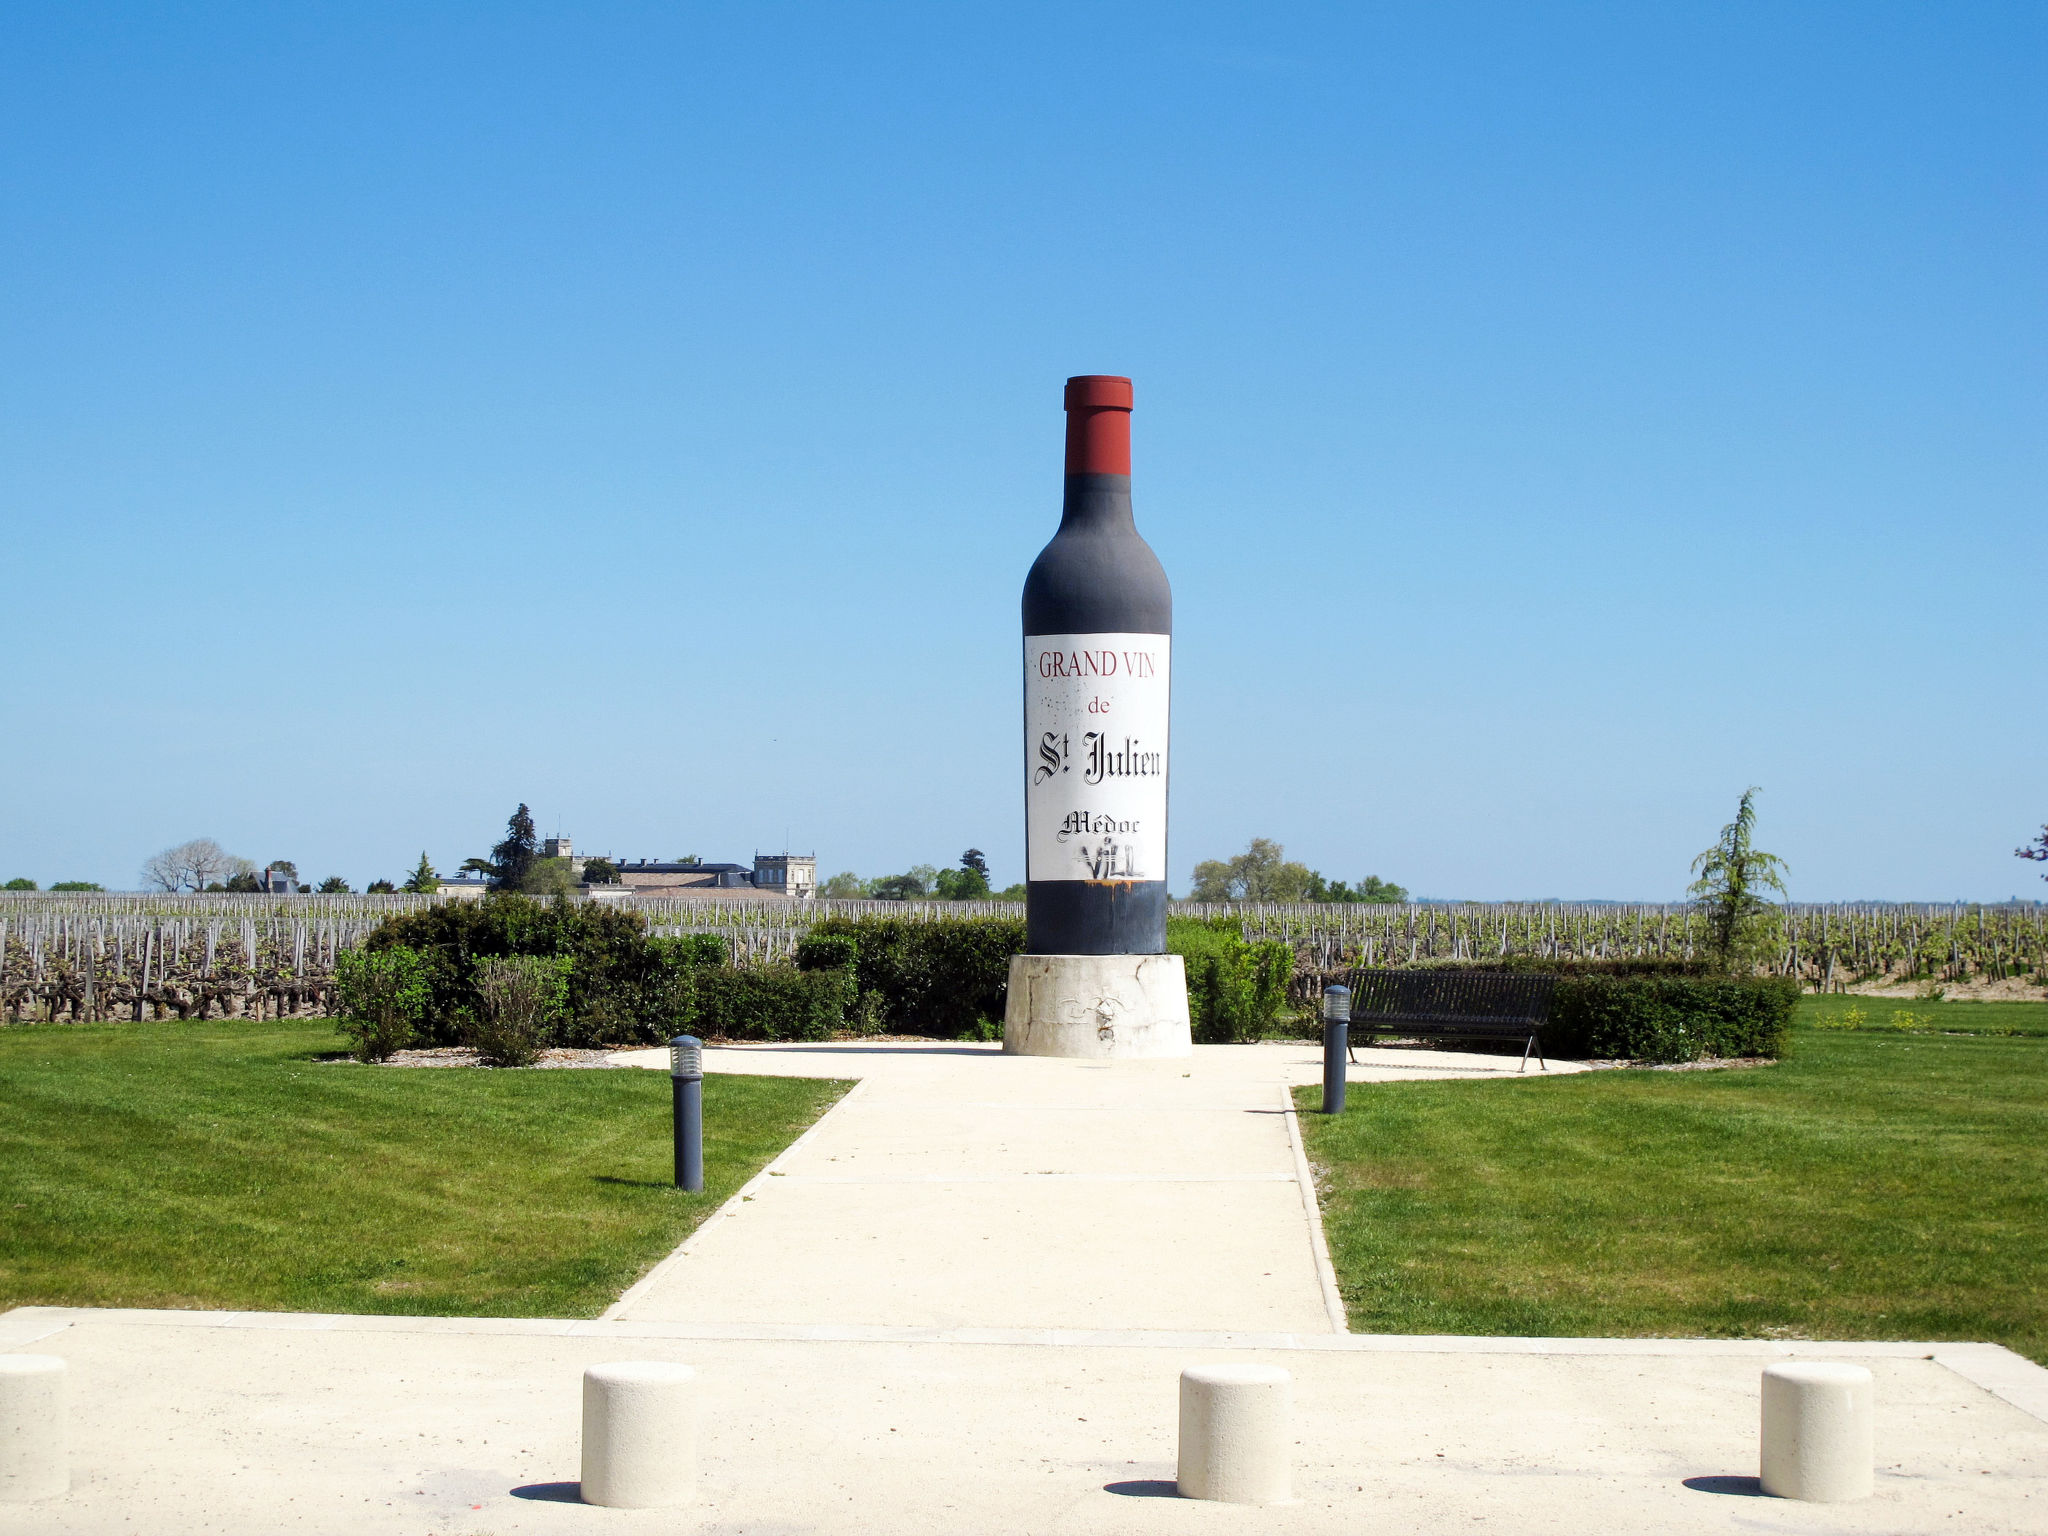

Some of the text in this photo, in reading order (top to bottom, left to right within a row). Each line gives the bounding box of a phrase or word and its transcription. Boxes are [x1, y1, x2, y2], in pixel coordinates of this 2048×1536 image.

[1040, 650, 1155, 678] GRAND VIN
[1088, 696, 1110, 714] de
[1082, 731, 1160, 786] Julien
[1056, 810, 1140, 843] Médoc
